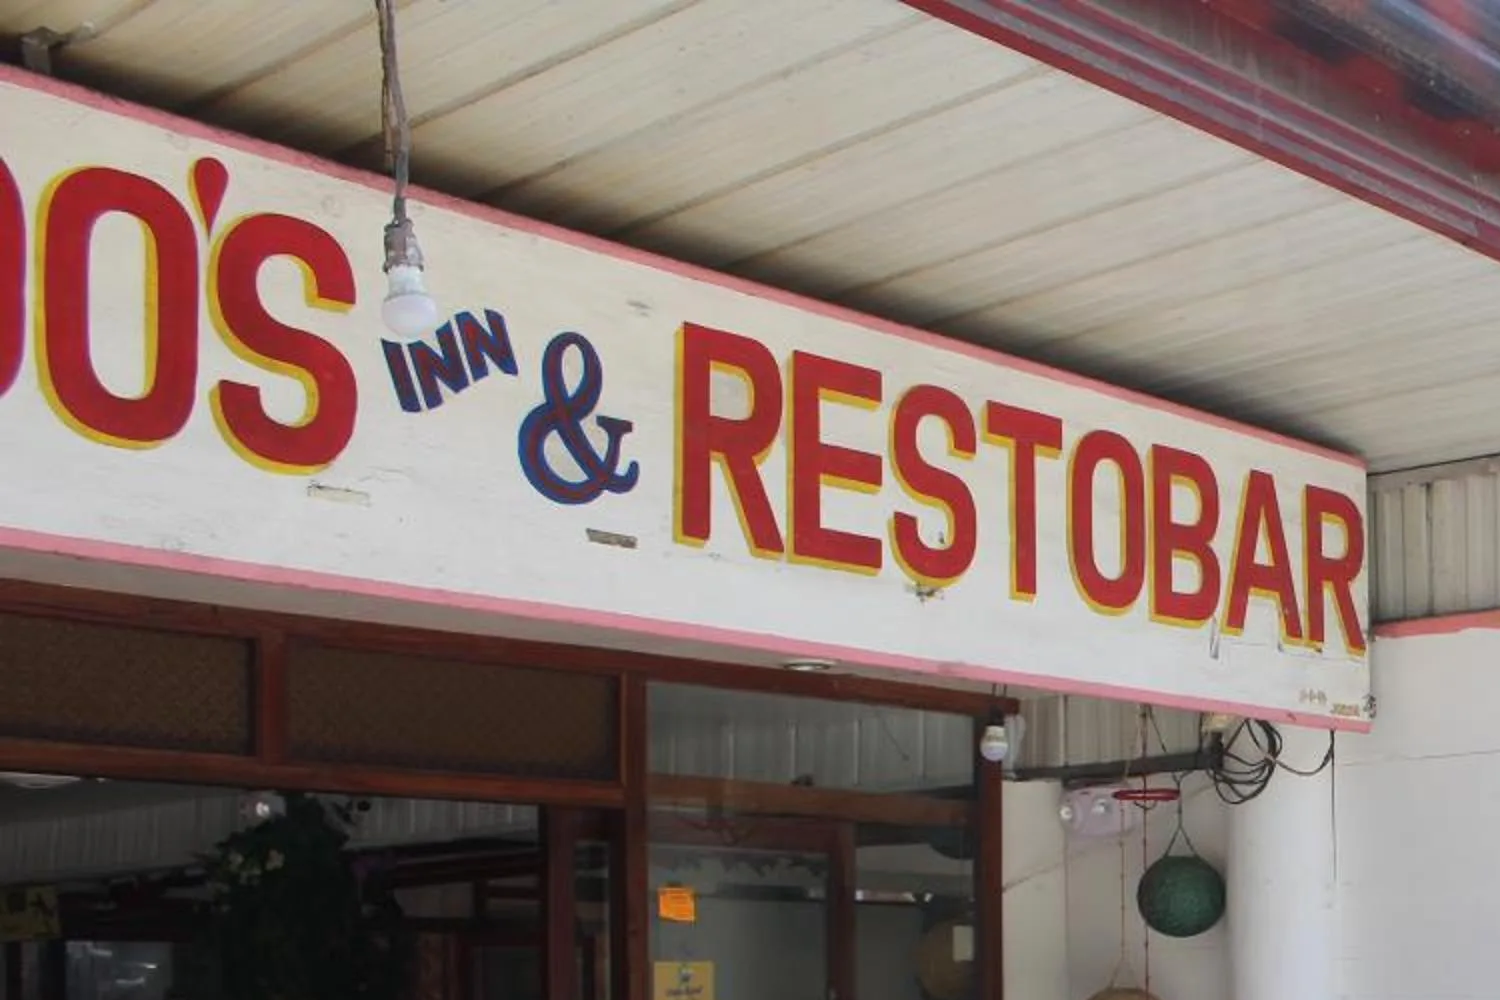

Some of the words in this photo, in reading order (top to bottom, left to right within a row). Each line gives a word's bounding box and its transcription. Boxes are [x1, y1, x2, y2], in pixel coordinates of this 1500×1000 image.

[0, 155, 358, 476] O'S
[381, 309, 519, 413] INN
[517, 331, 639, 505] &
[673, 321, 1366, 656] RESTOBAR
